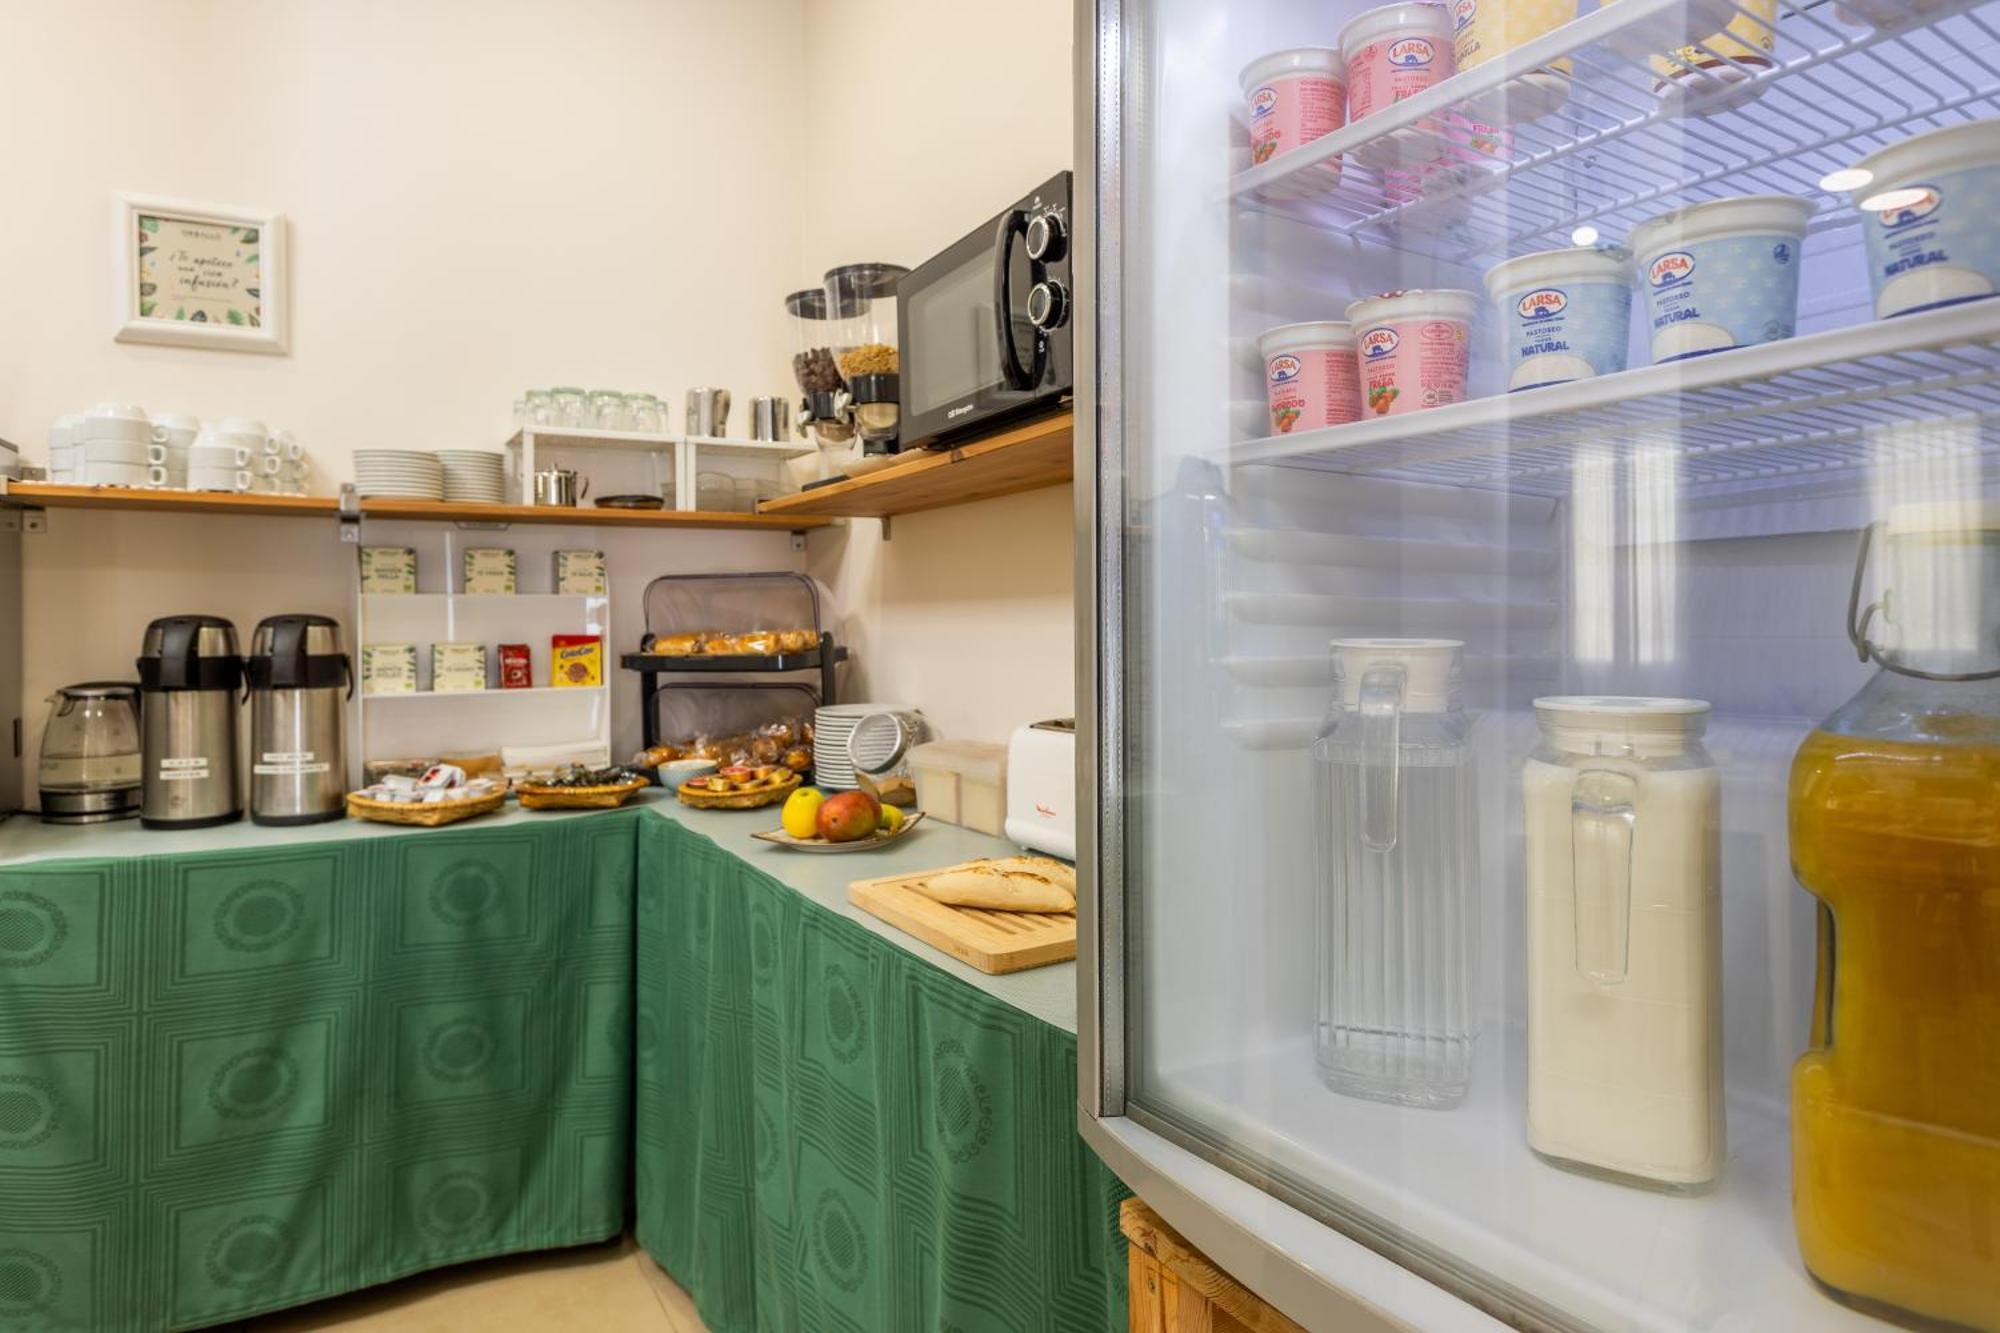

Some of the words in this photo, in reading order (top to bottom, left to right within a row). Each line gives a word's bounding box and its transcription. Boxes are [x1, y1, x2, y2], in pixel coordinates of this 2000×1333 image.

[1393, 43, 1430, 58] LARSA
[194, 257, 232, 269] apetece
[1652, 257, 1689, 279] LARSA
[1884, 249, 1949, 277] NATURAL
[1522, 294, 1562, 312] LARSA
[1654, 307, 1701, 329] NATURAL
[1526, 326, 1562, 337] PASTOREO
[1364, 333, 1394, 350] LARSA
[1521, 341, 1570, 357] NATURAL
[1271, 360, 1297, 375] LARSA
